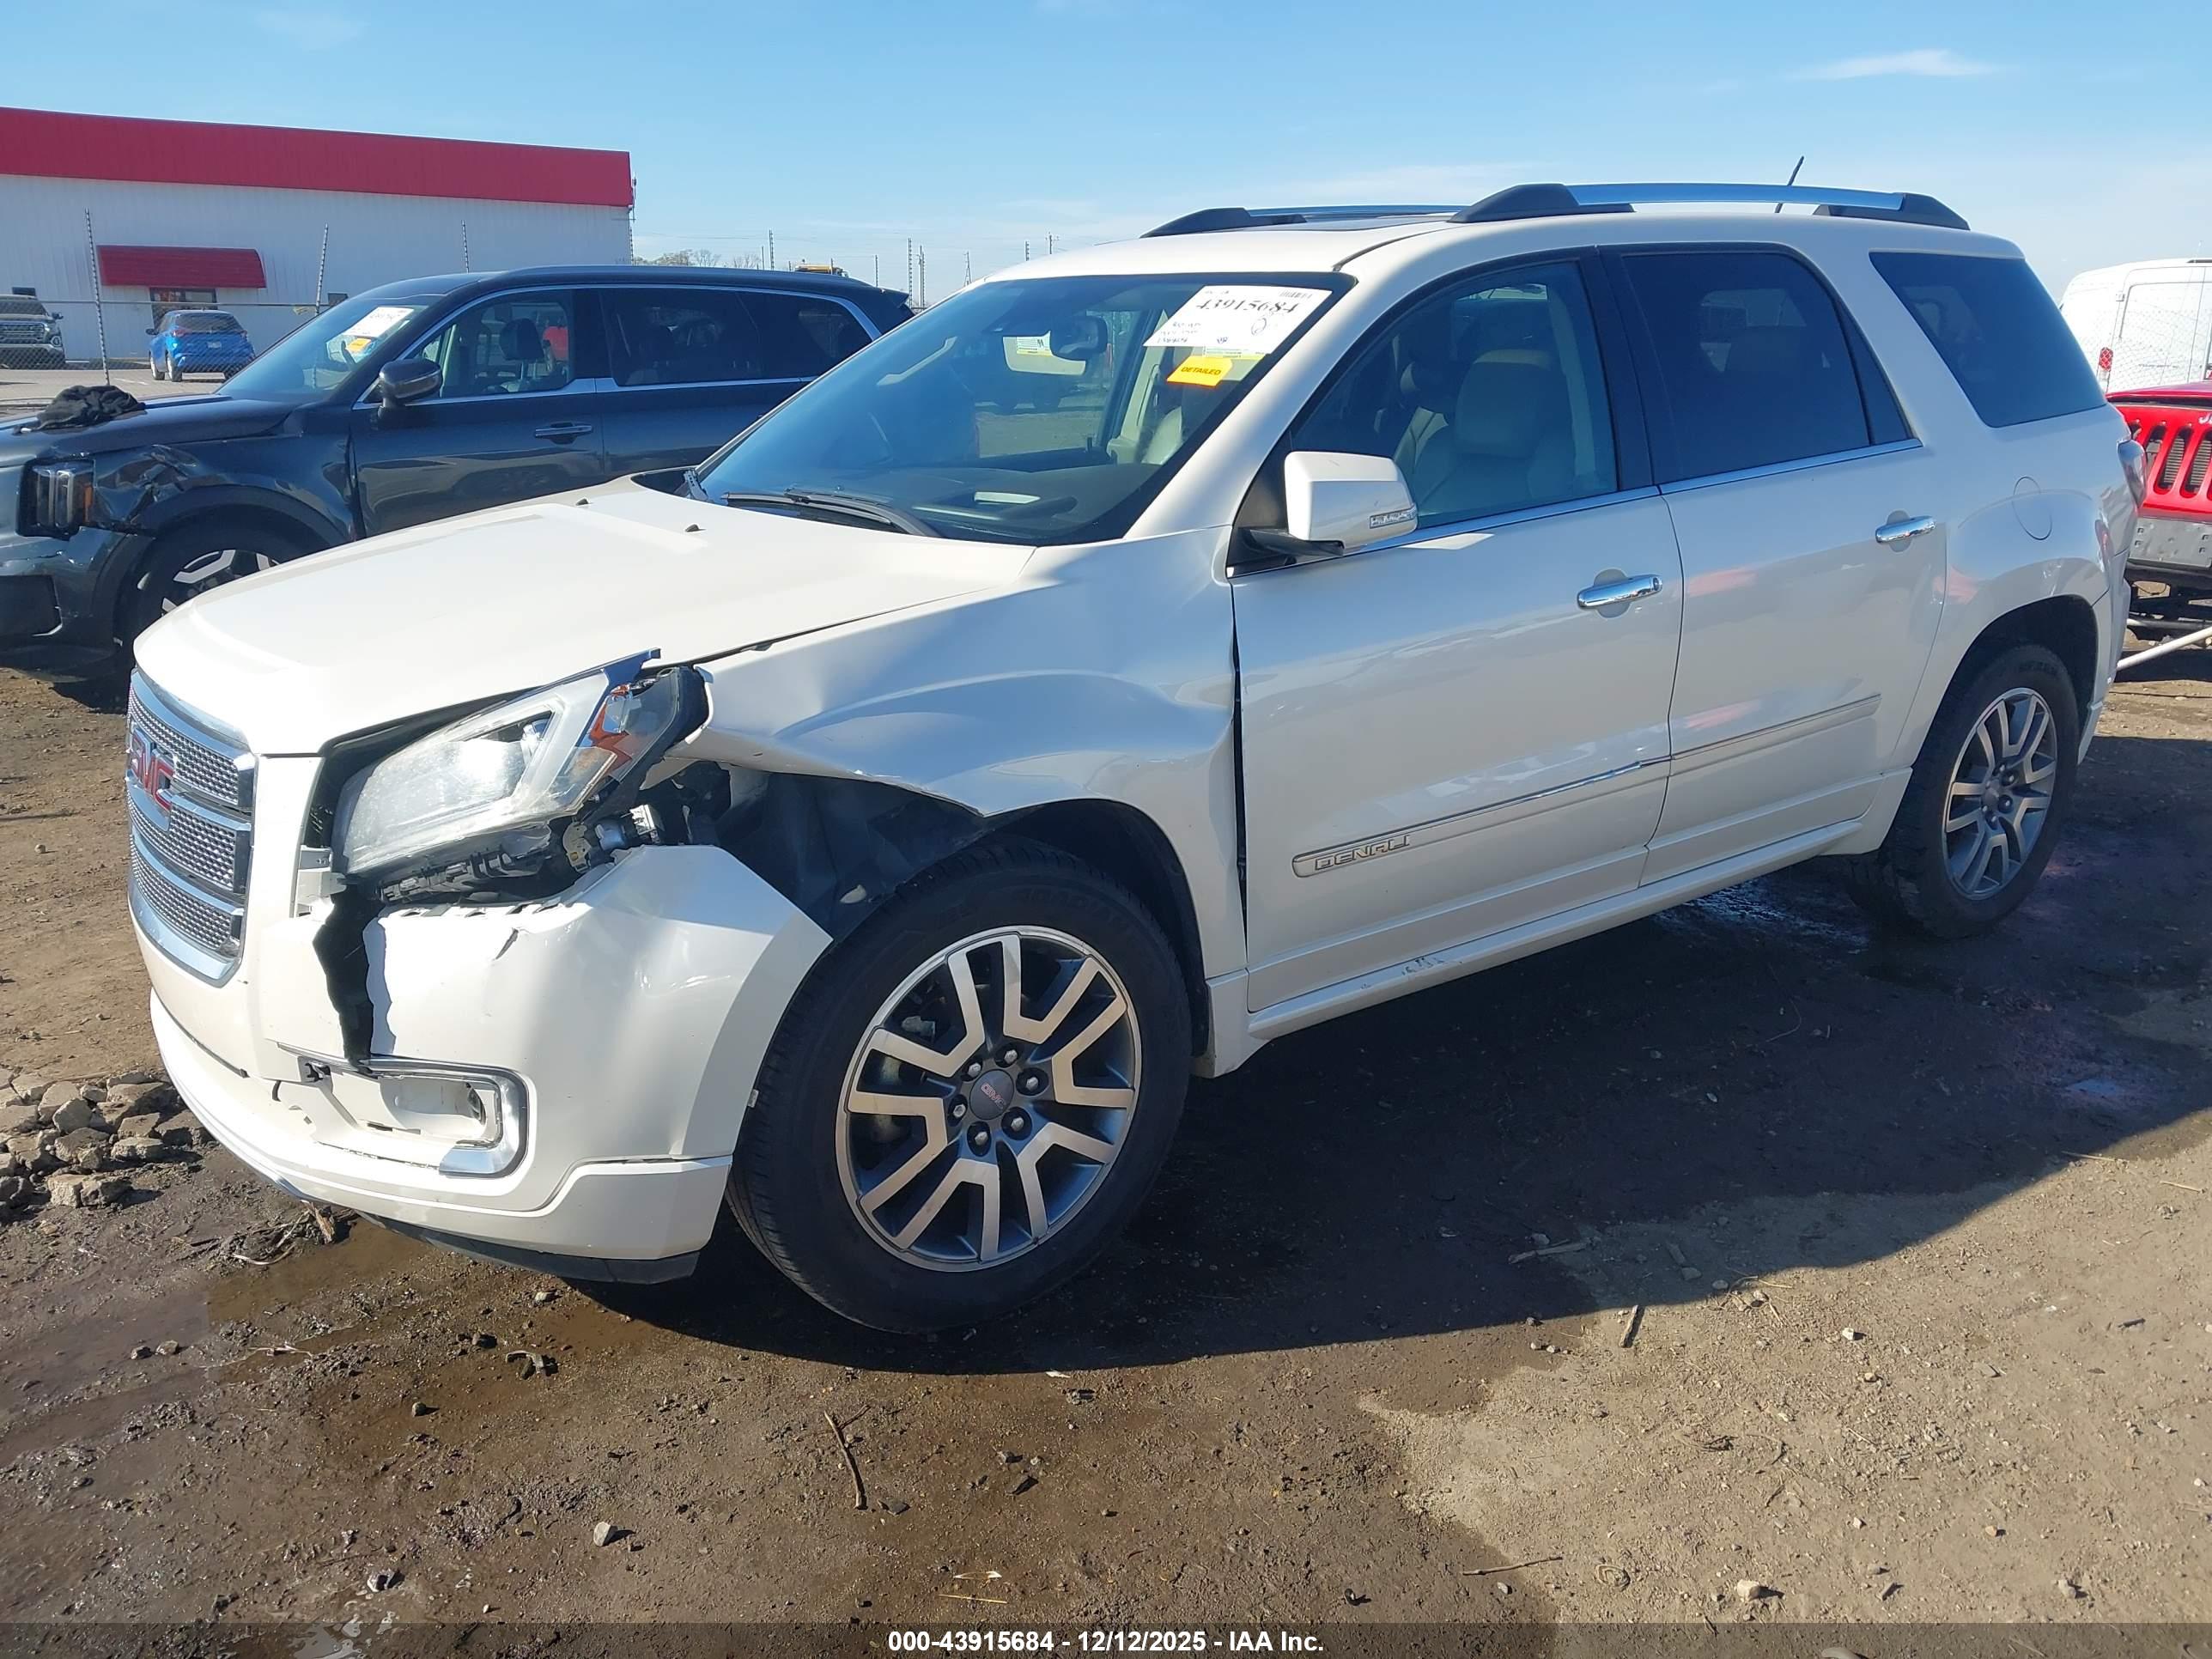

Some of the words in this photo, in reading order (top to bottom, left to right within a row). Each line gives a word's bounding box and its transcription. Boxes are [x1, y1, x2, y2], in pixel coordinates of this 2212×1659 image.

[1195, 299, 1300, 313] 43915684
[1181, 366, 1222, 376] DETAILED
[1315, 835, 1411, 871] DENALI
[981, 1083, 1007, 1110] GMC
